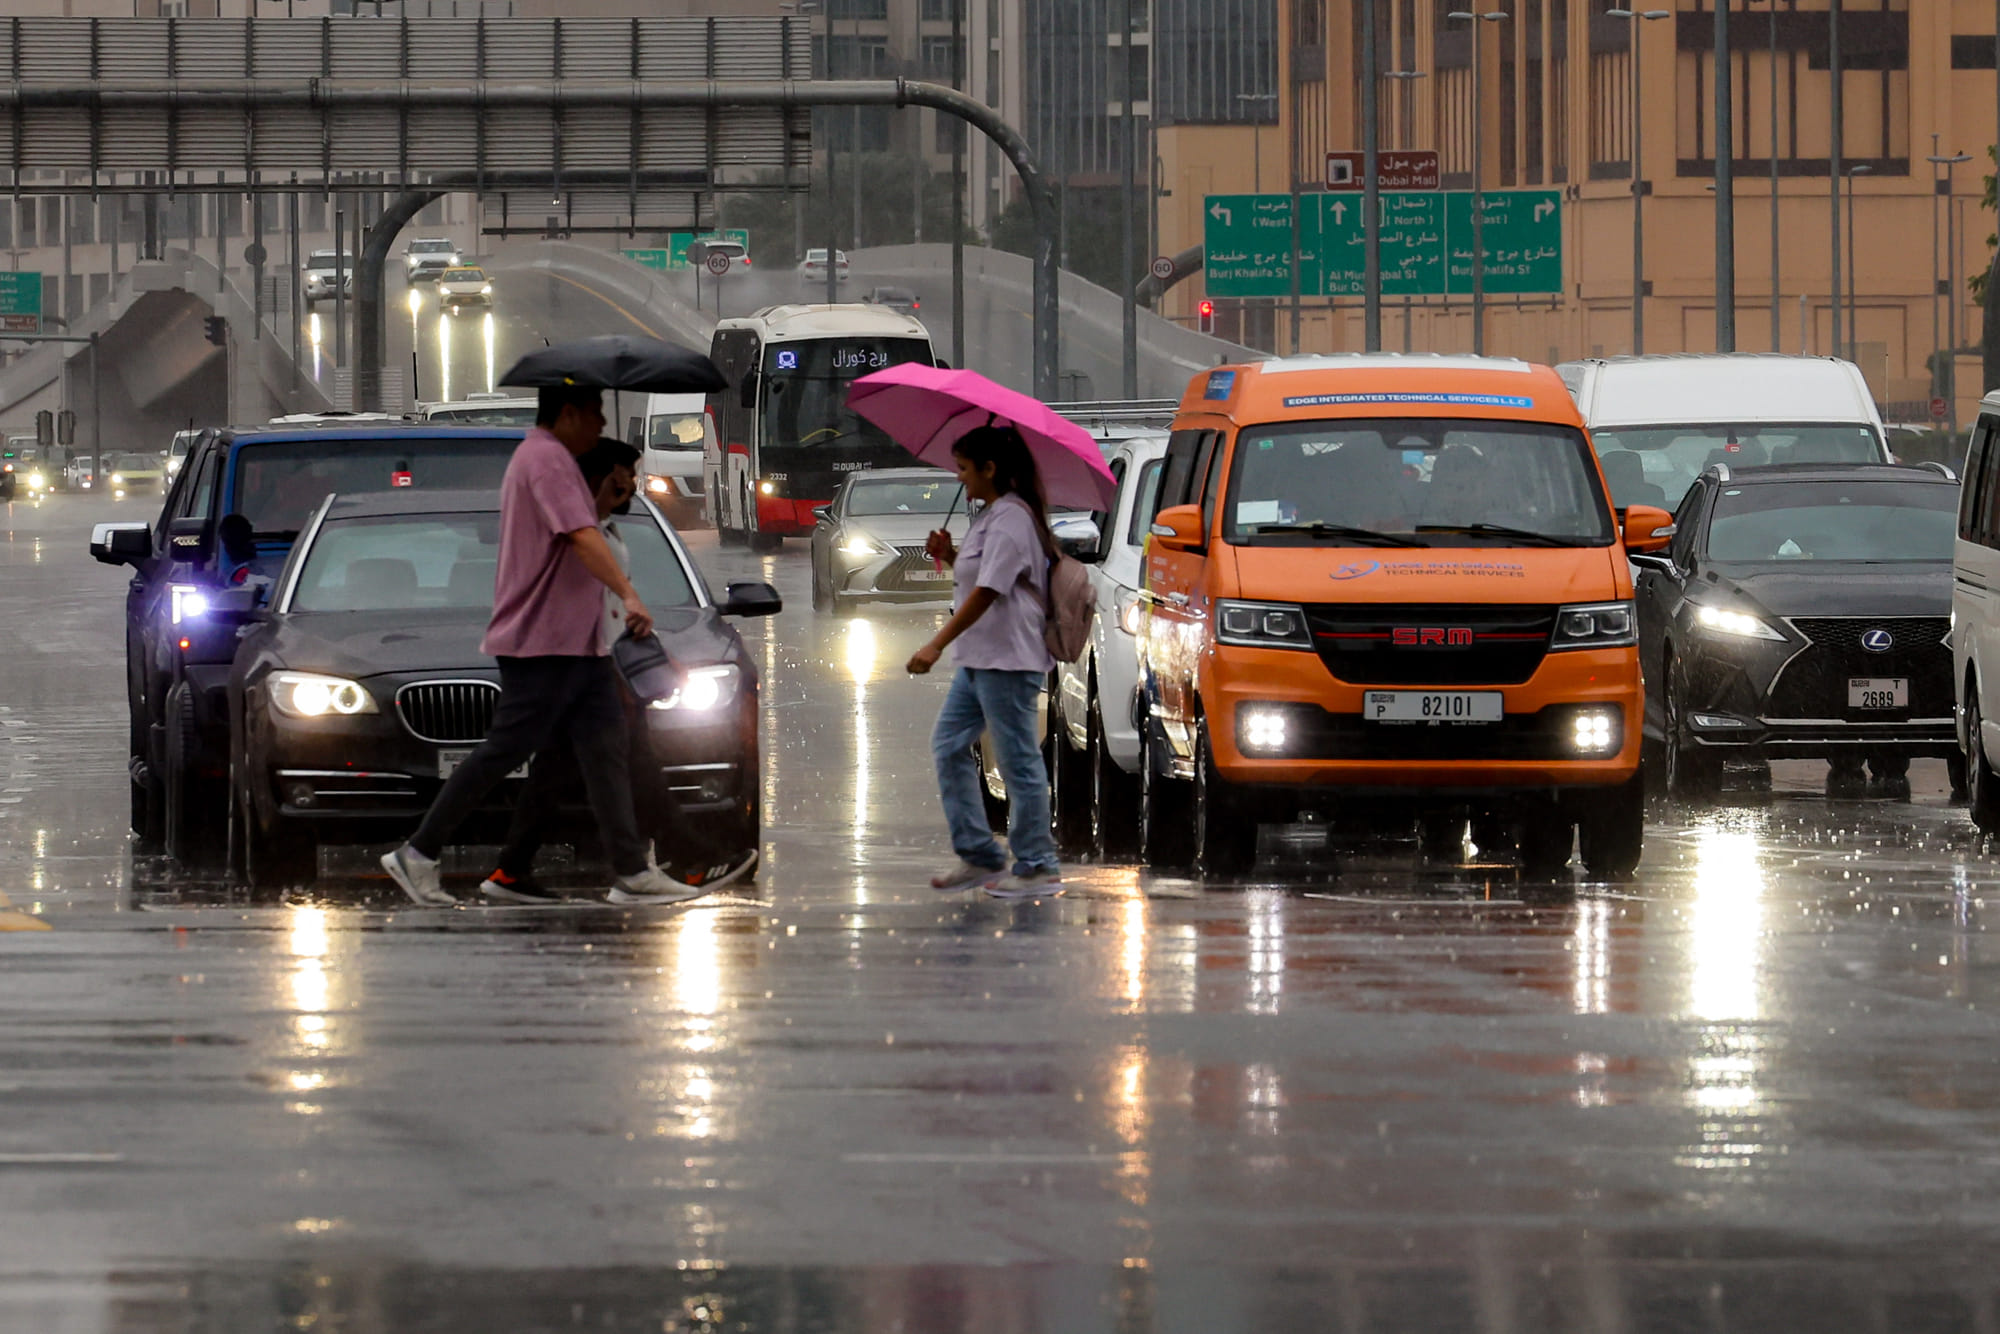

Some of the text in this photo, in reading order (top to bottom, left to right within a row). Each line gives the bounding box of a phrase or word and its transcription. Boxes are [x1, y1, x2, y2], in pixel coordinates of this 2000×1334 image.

[1384, 156, 1436, 171] دبي مول
[1378, 175, 1409, 186] Dubai
[1412, 175, 1436, 186] Mall
[1471, 213, 1508, 225] (ast)
[1404, 231, 1438, 247] شارع
[1210, 249, 1316, 265] شاع برج خليفة
[1496, 249, 1519, 262] برج
[1523, 246, 1557, 262] شارع
[712, 258, 726, 268] 60
[1155, 263, 1170, 273] 60
[1399, 254, 1423, 269] دبي
[1209, 267, 1289, 280] Burj Khalifa St
[1329, 271, 1342, 280] Al
[1405, 269, 1417, 280] St
[1483, 263, 1515, 275] halifa
[1517, 263, 1531, 275] St
[1329, 281, 1384, 293] Bur Dui
[832, 349, 888, 368] برج كورال
[1288, 397, 1318, 406] EDGE
[1319, 394, 1386, 404] INTEGRATED
[1386, 393, 1447, 402] TECHNICAL
[1447, 394, 1499, 404] SERVICES
[769, 473, 788, 481] 2332
[1462, 569, 1525, 578] SERVICES
[1393, 627, 1473, 645] SRM
[1892, 679, 1901, 690] T
[1862, 691, 1894, 708] 2689
[1376, 695, 1472, 718] P 82101
